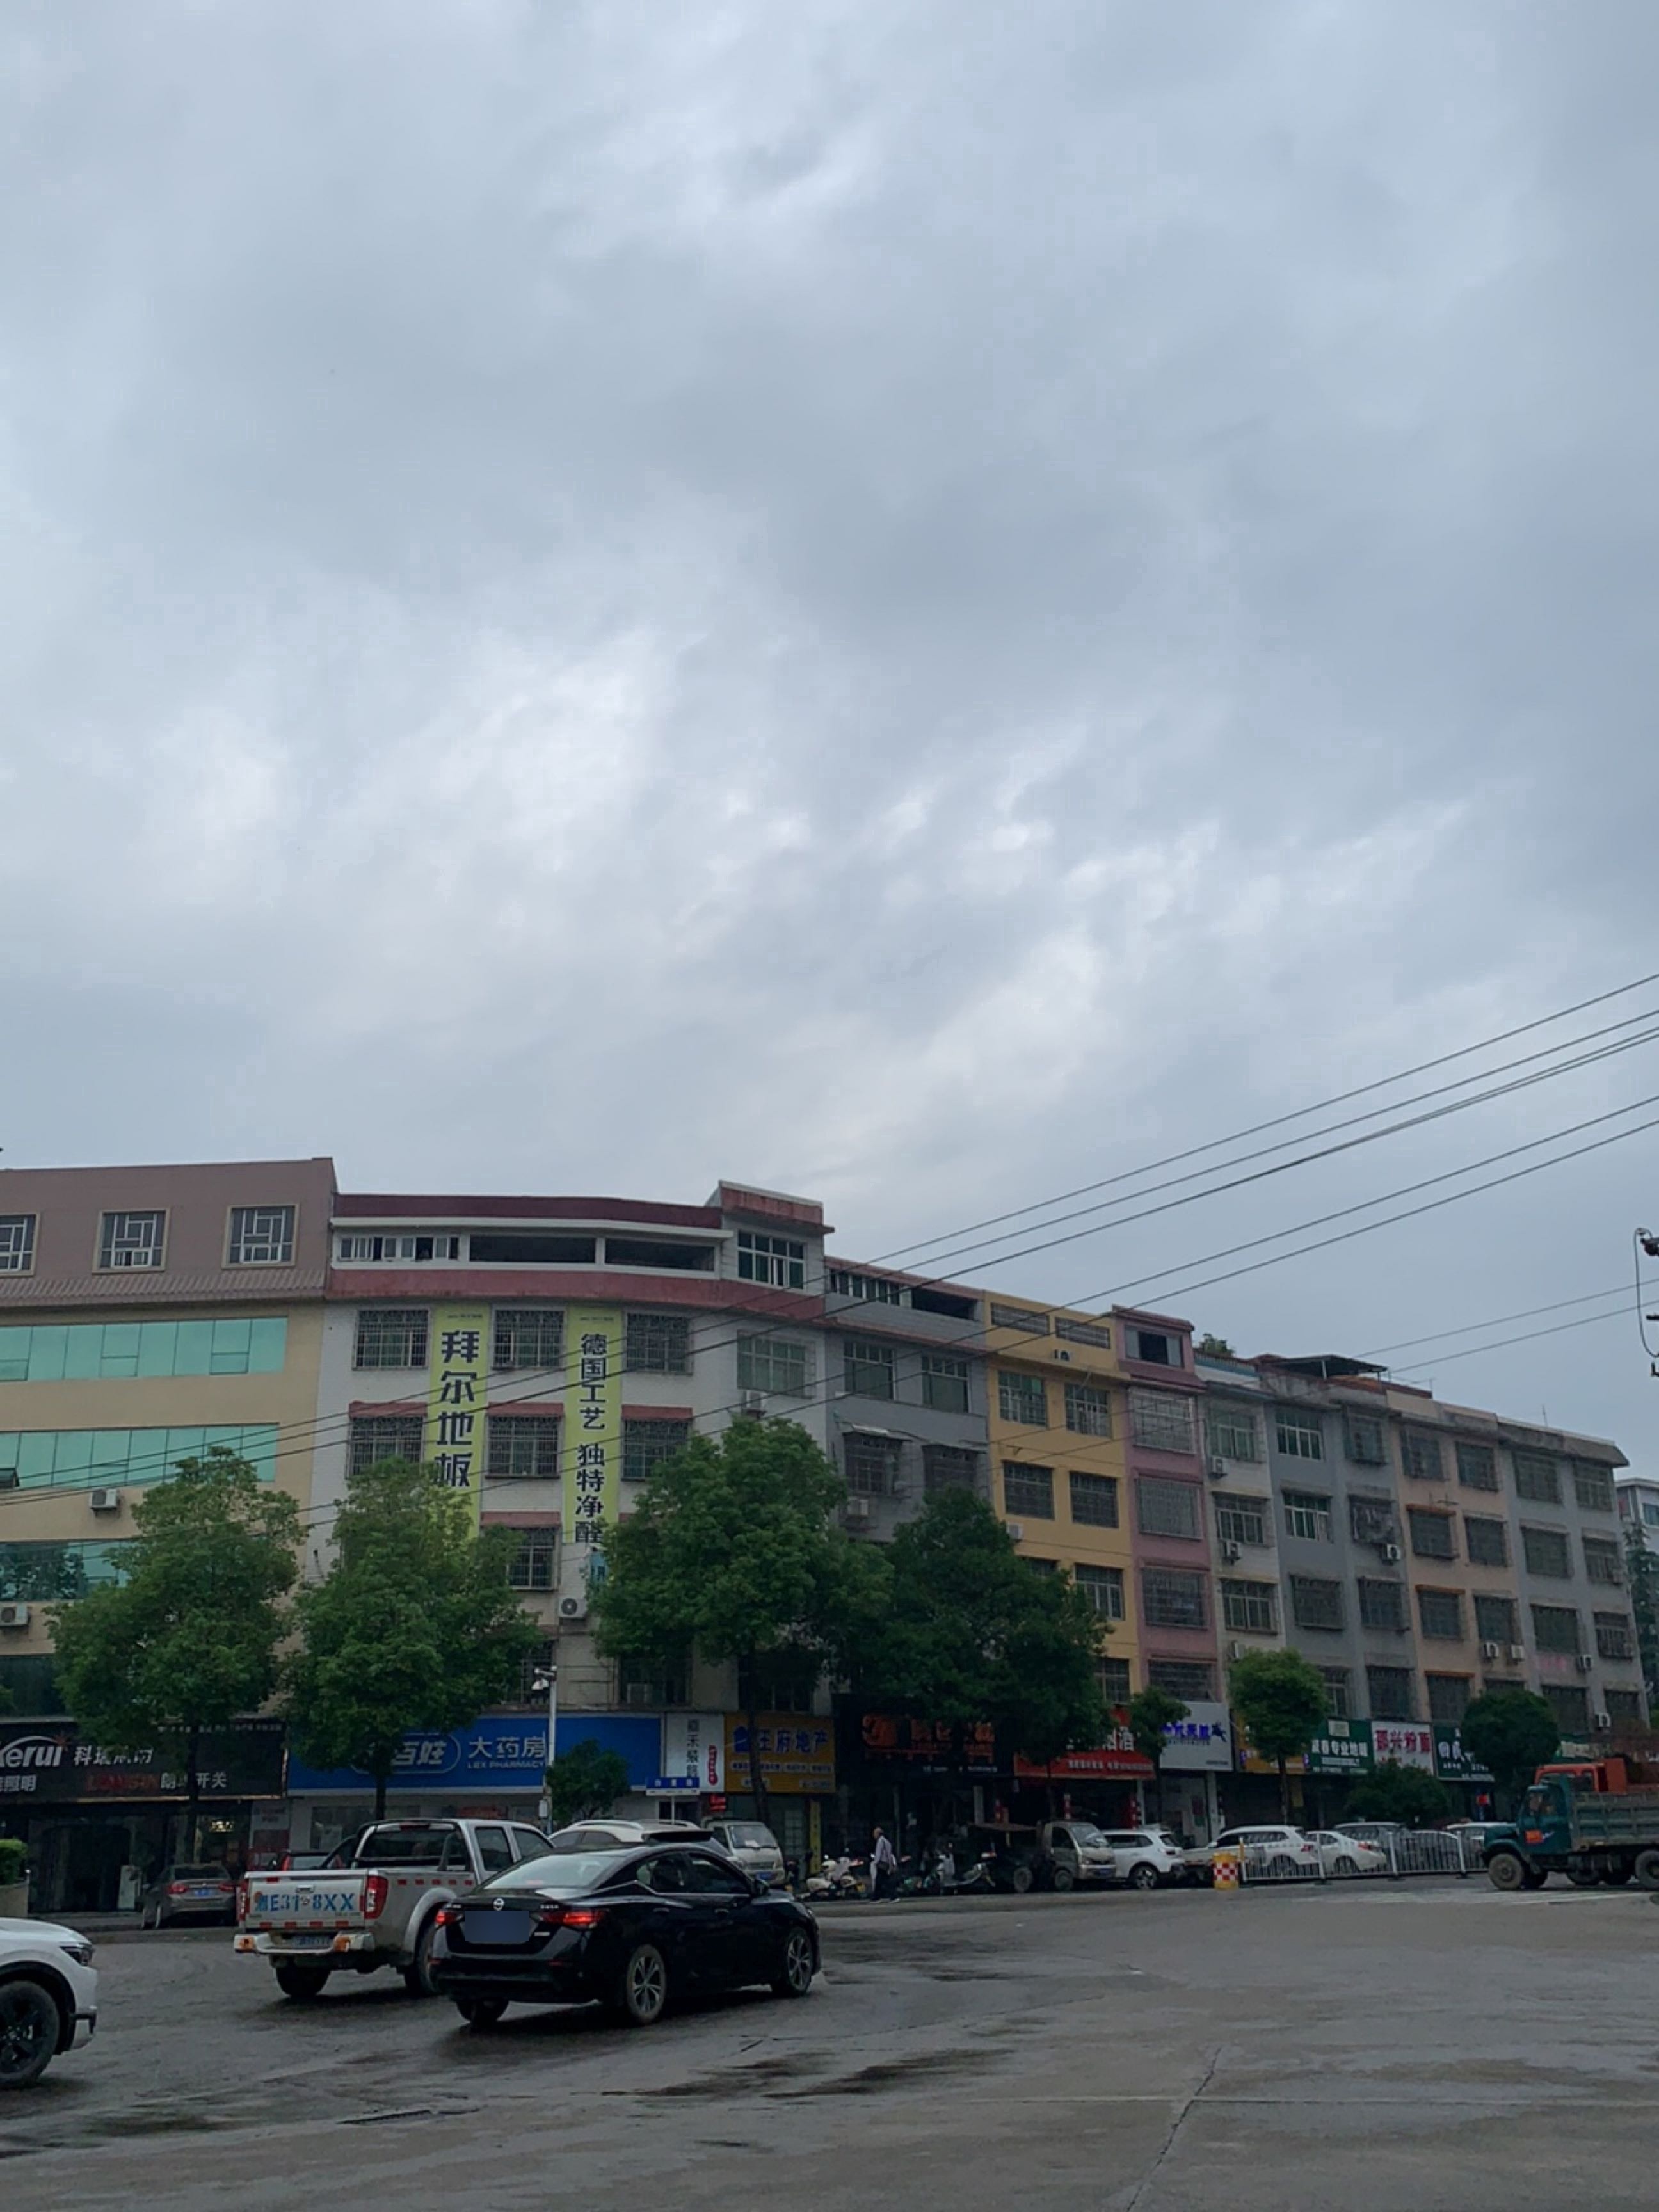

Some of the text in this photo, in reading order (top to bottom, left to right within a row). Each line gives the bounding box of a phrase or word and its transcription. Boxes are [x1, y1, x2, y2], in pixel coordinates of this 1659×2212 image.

[579, 1333, 607, 1431] 德国工艺
[434, 1330, 480, 1488] 拜尔地板
[575, 1443, 605, 1544] 独特净醛
[0, 1742, 63, 1768] erui
[369, 1740, 448, 1767] 百姓
[467, 1735, 547, 1760] 大药房
[0, 1775, 37, 1793] 照明
